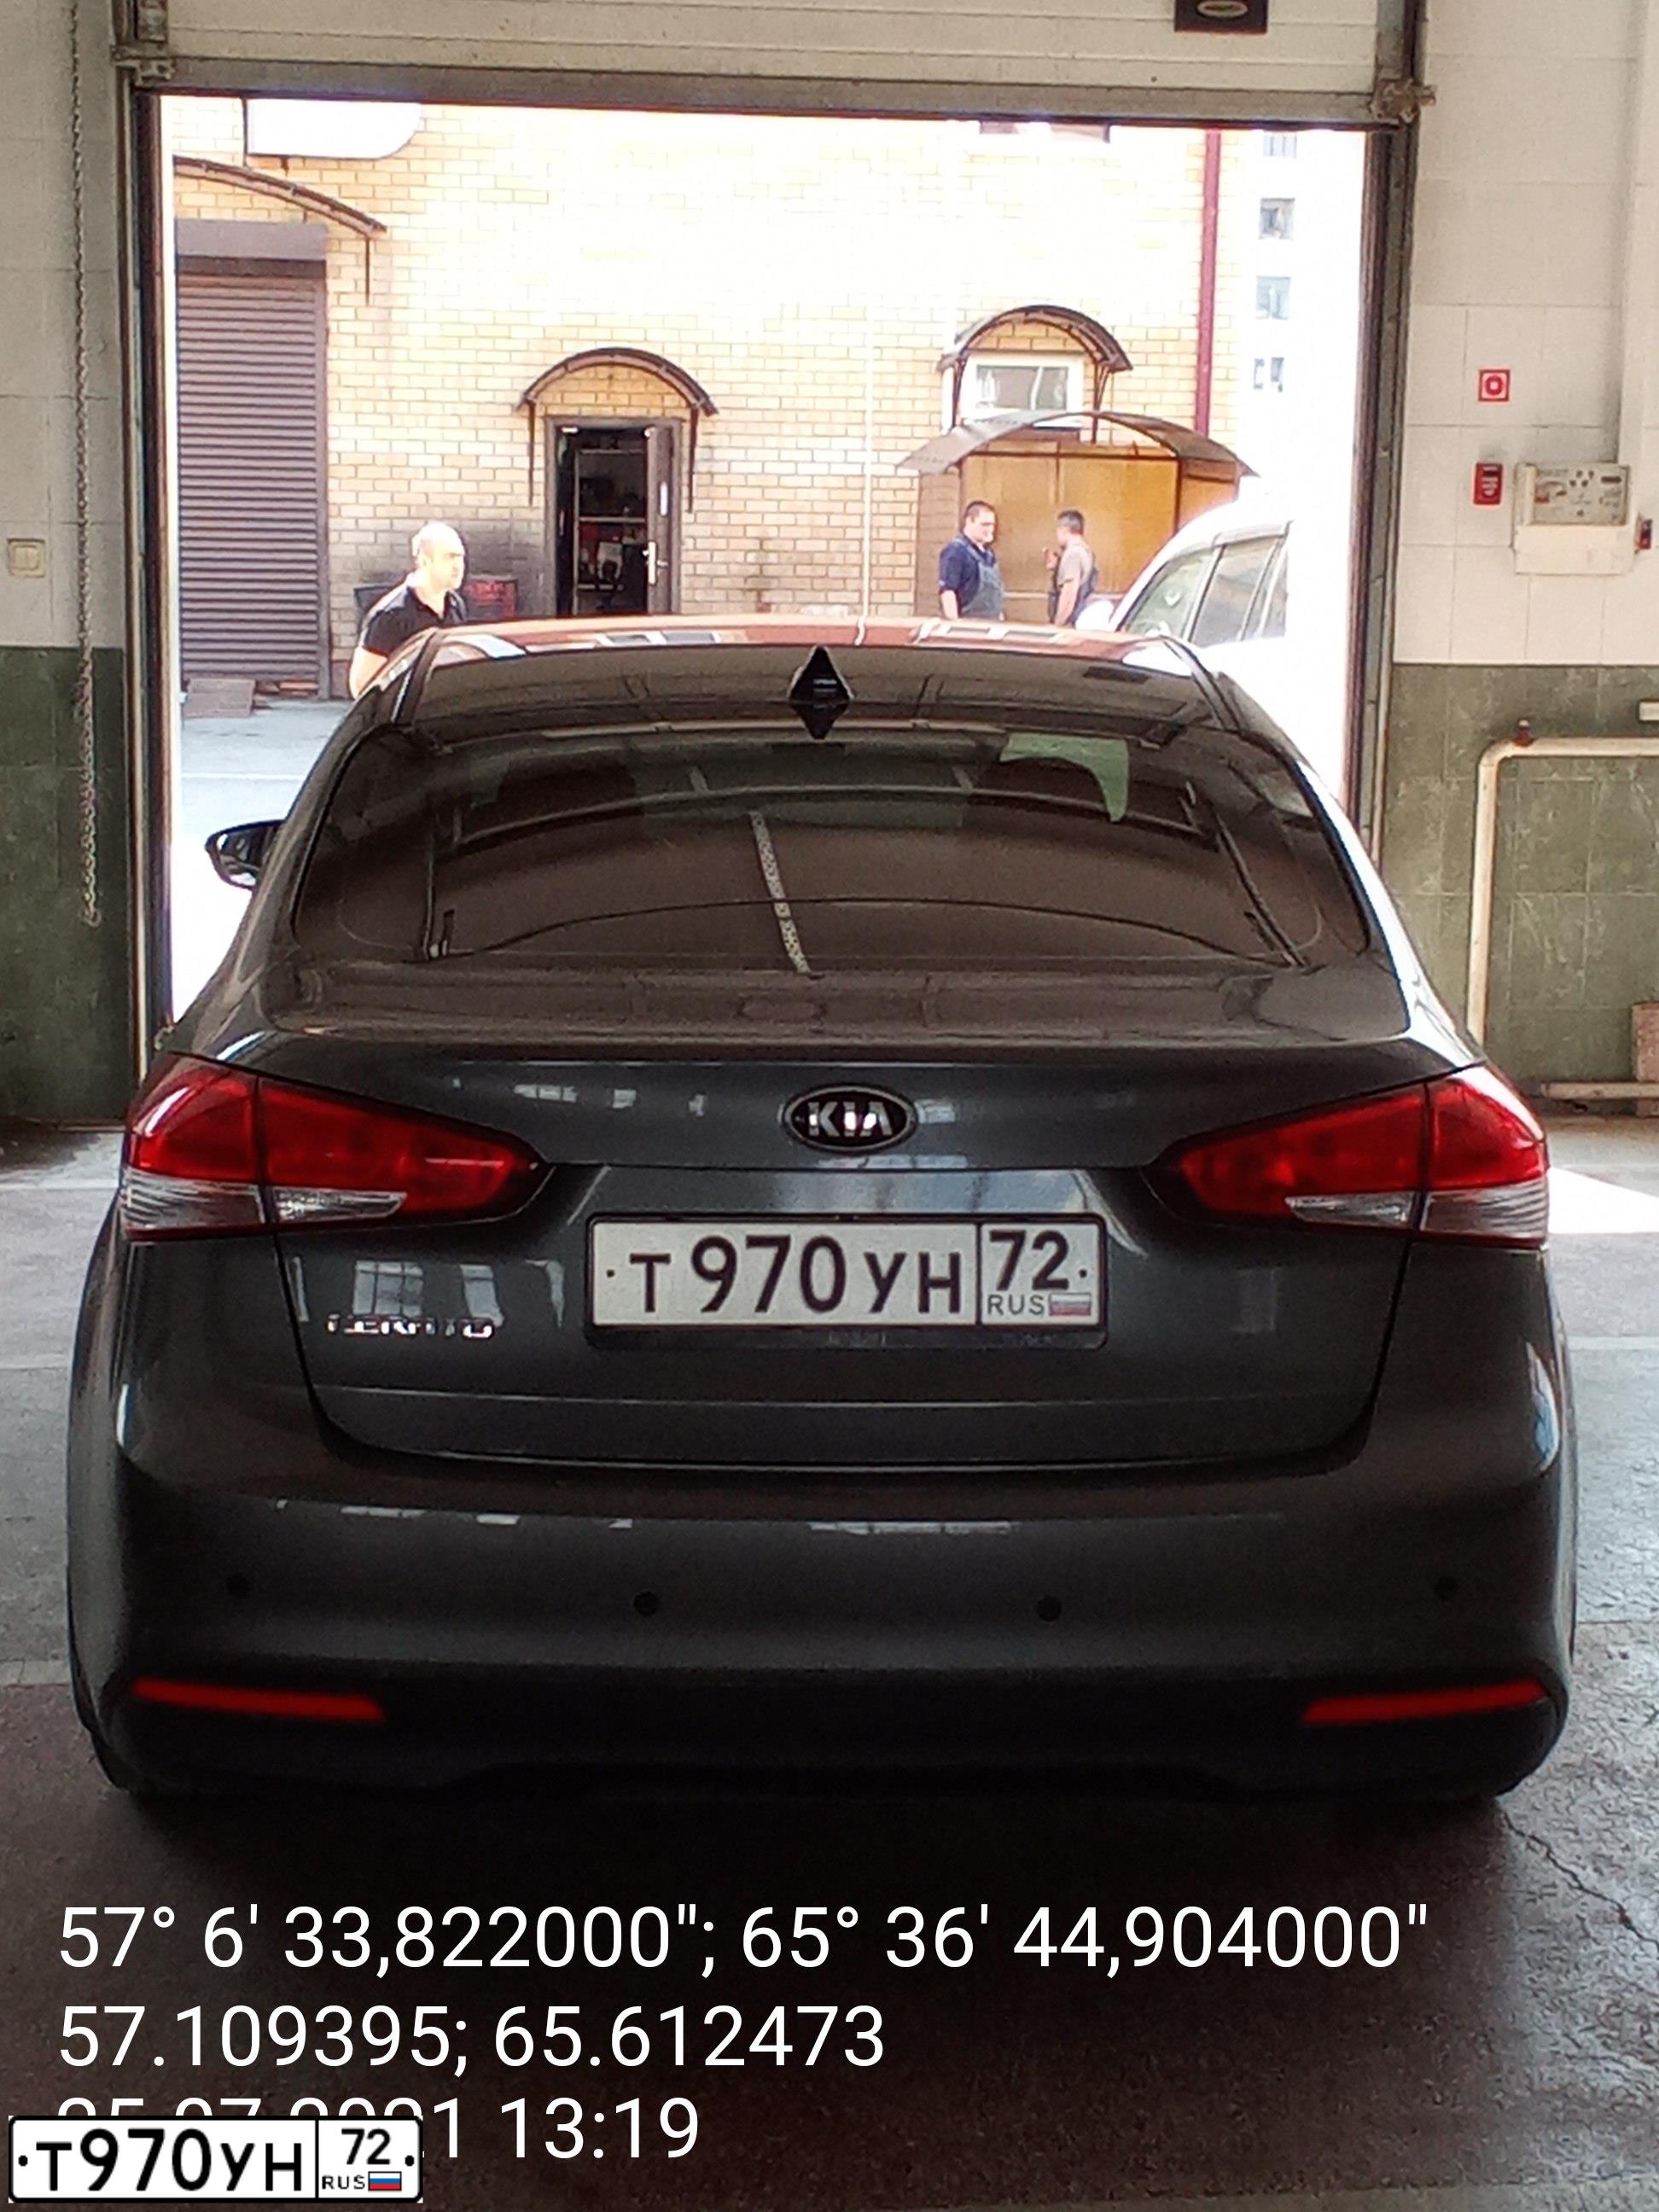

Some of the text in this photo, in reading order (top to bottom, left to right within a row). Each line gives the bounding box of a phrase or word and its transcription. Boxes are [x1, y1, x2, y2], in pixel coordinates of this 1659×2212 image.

[807, 1101, 893, 1138] KIA
[629, 1229, 1070, 1313] Т970УН 72
[987, 1293, 1045, 1317] RUS
